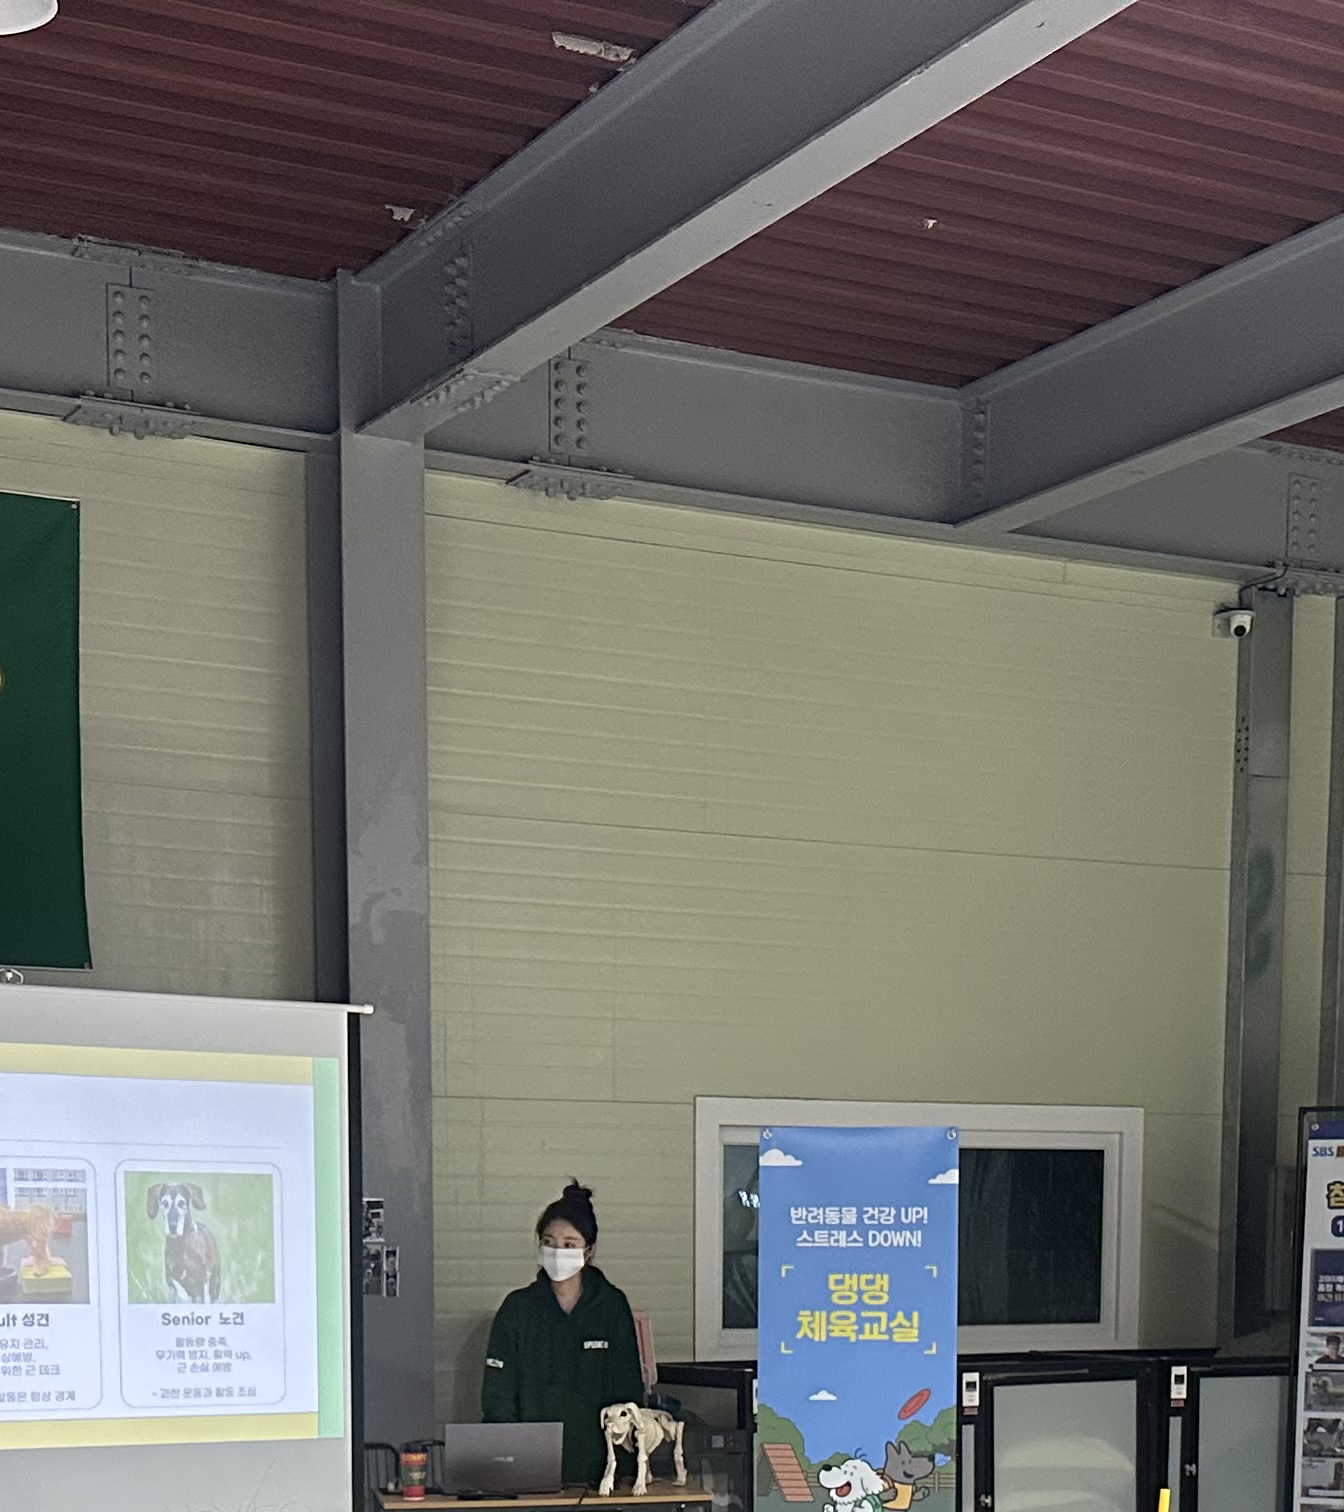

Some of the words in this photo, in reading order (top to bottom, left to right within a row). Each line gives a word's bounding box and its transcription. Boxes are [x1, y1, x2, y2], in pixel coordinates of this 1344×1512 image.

[1312, 1146, 1335, 1157] SBS
[790, 1206, 857, 1225] 반려동물
[862, 1206, 897, 1225] 건강
[900, 1207, 928, 1224] UP!
[796, 1230, 864, 1248] 스트레스
[868, 1230, 922, 1247] DOWN!
[828, 1273, 890, 1306] 댕댕
[22, 1313, 50, 1327] 성견
[161, 1312, 212, 1326] Senior
[219, 1312, 245, 1326] 노견
[796, 1310, 920, 1343] 체육교실
[0, 1338, 20, 1350] 유지
[0, 1365, 22, 1376] 위한
[30, 1391, 52, 1402] 항상
[55, 1390, 76, 1402] 경계
[160, 1387, 181, 1399] 과한
